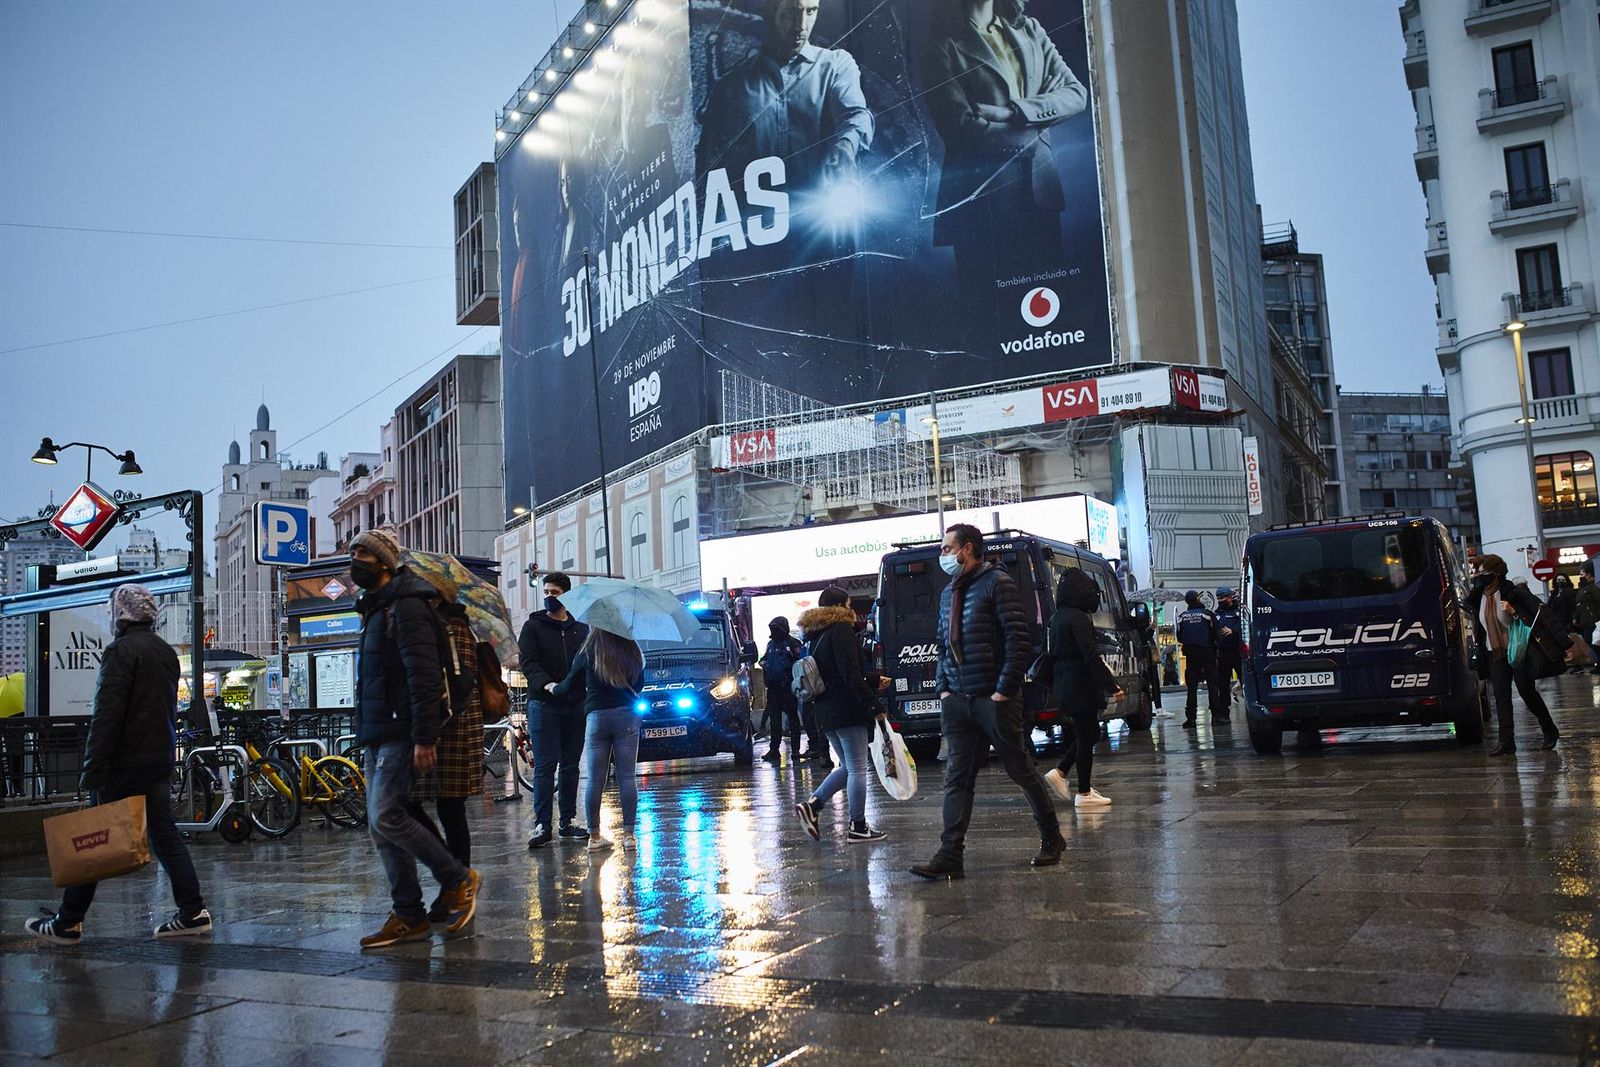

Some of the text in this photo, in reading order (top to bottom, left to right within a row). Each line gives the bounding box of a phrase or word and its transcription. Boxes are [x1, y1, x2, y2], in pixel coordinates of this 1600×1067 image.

[608, 150, 667, 211] EL MAL TIENE
[615, 178, 661, 225] UN PRECIO
[561, 155, 790, 358] 30 MONEDAS
[996, 267, 1080, 288] También incluido en
[1000, 329, 1085, 355] vodafone
[613, 334, 676, 385] 29 DE NOVIEMBRE
[628, 370, 661, 418] HBO
[1047, 386, 1094, 409] VSA
[1100, 397, 1109, 407] 91
[1111, 394, 1123, 406] 404
[630, 413, 662, 443] ESPAÑA
[267, 509, 298, 557] P
[815, 546, 837, 558] Usa
[840, 540, 888, 556] autobús
[1257, 606, 1272, 614] 7159
[1266, 618, 1428, 650] POLICÍA
[898, 643, 939, 658] POLIC
[641, 681, 695, 692] OLICÍA
[1278, 673, 1331, 686] 7803 LCP
[1390, 672, 1431, 689] 092
[910, 701, 933, 711] 8585
[646, 726, 686, 737] 7599 LCP
